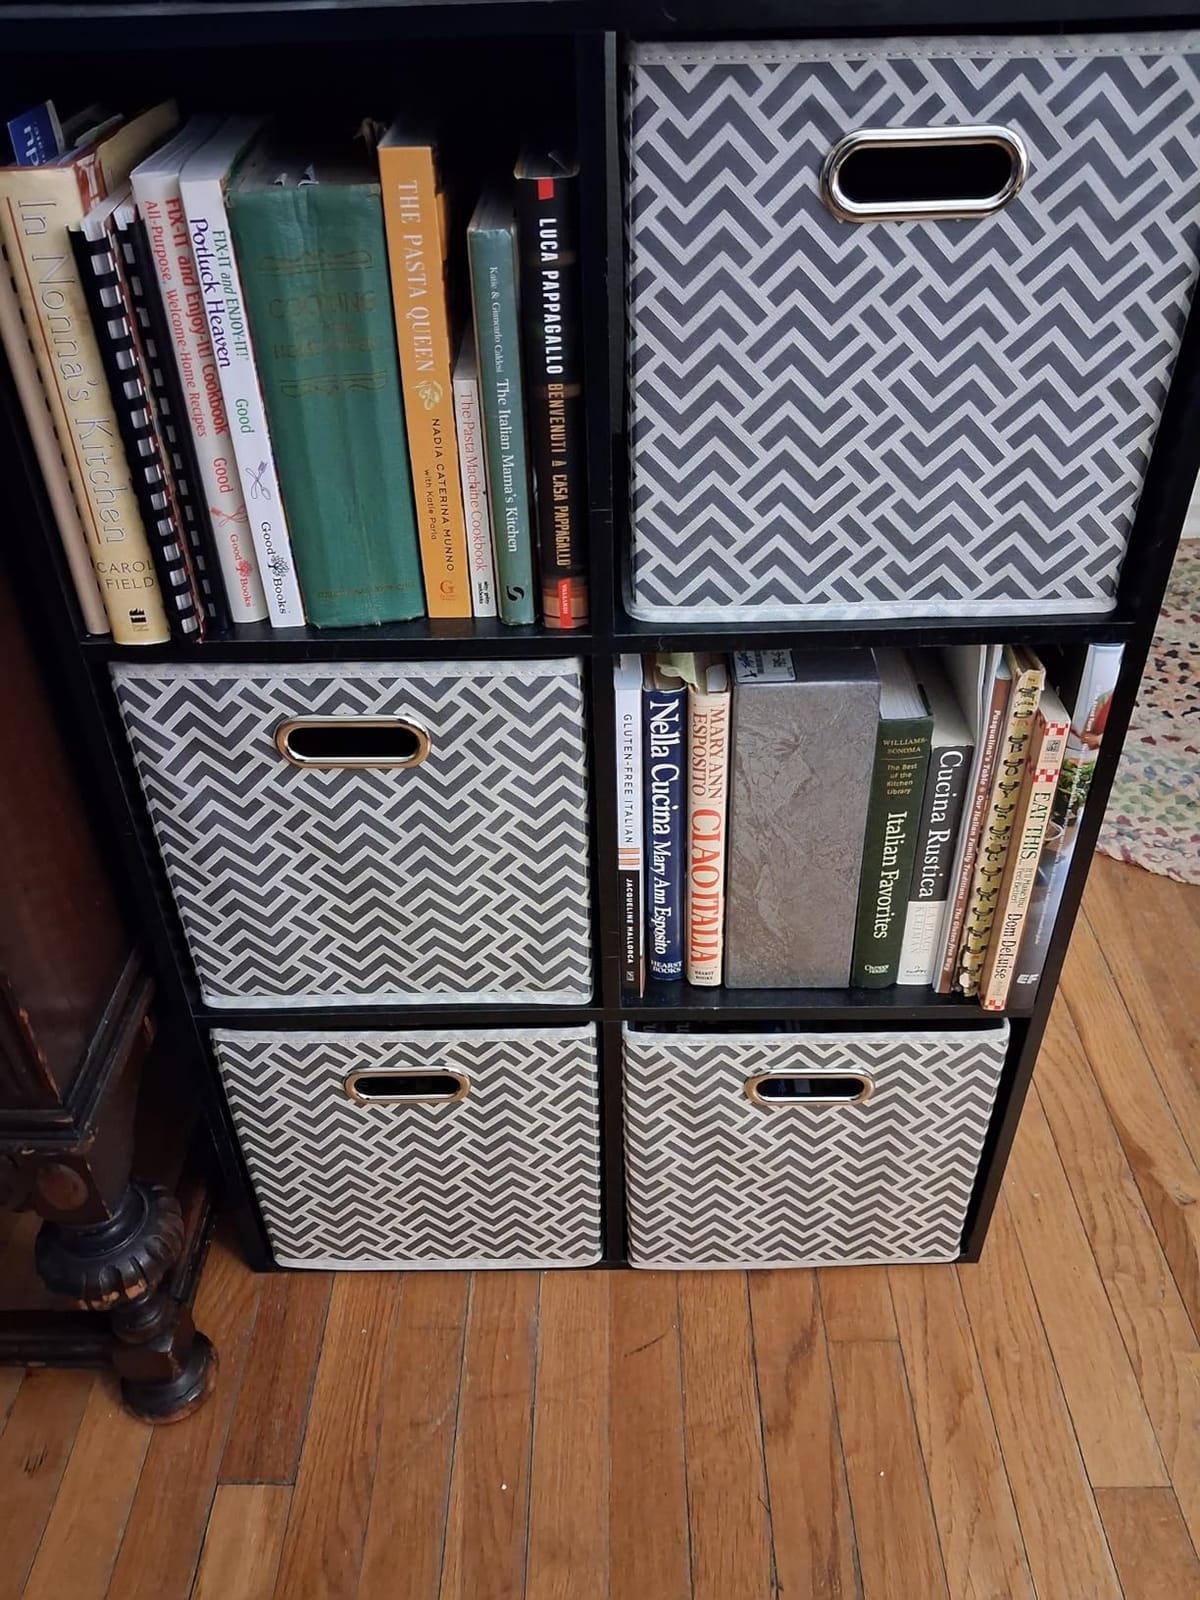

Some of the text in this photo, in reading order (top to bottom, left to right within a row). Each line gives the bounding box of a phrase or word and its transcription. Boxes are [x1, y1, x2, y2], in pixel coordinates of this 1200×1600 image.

[165, 197, 189, 247] FIX-IT
[177, 255, 196, 287] and
[399, 181, 435, 372] THE PASTA QUEEN
[190, 219, 231, 368] Potluck Heaven
[212, 230, 250, 361] FIX-IT and ENJOY-IT!
[539, 218, 564, 375] LUCA PAPPAGALLO
[18, 200, 128, 543] In Nonna's Kitchen
[167, 289, 195, 387] Welcome-Home
[190, 392, 208, 437] Recipes
[235, 399, 255, 434] Good
[461, 391, 474, 418] The
[463, 422, 476, 453] Pasta
[548, 383, 568, 453] BENVENUTI
[213, 457, 233, 494] Good
[432, 418, 454, 572] NADIA CATERINA MUNNO
[466, 456, 480, 508] Machine
[496, 379, 519, 552] The Italian Mama's Kitchen
[552, 474, 568, 499] CASA
[424, 469, 437, 540] with Katie Parla
[553, 506, 572, 567] PAPPAGALLO
[96, 560, 154, 574] CAROL
[230, 534, 251, 608] Good Books
[260, 522, 287, 614] Good Books
[468, 509, 486, 571] Cookbook
[106, 577, 154, 590] FIELD
[650, 699, 680, 835] Nella Cucina
[692, 713, 708, 796] ESPOSITO
[708, 709, 725, 800] MARY ANN
[985, 709, 1001, 762] Pasqualina's
[623, 713, 634, 843] GLUTEN-FREE ITALIAN
[975, 795, 984, 809] Our
[980, 763, 991, 785] Table
[1029, 793, 1050, 823] EAT
[882, 811, 907, 867] Italian
[919, 751, 963, 898] Cucina Rustica
[965, 833, 976, 859] Family
[970, 810, 980, 831] Italian
[650, 841, 672, 955] Mary Ann Esposito
[691, 809, 721, 963] CIAO ITALIA
[873, 870, 899, 939] Favorites
[626, 879, 634, 963] JACQUELINE MALLORCA
[1004, 913, 1022, 938] Dom
[994, 939, 1016, 979] DeLuise
[1016, 974, 1039, 985] EF
